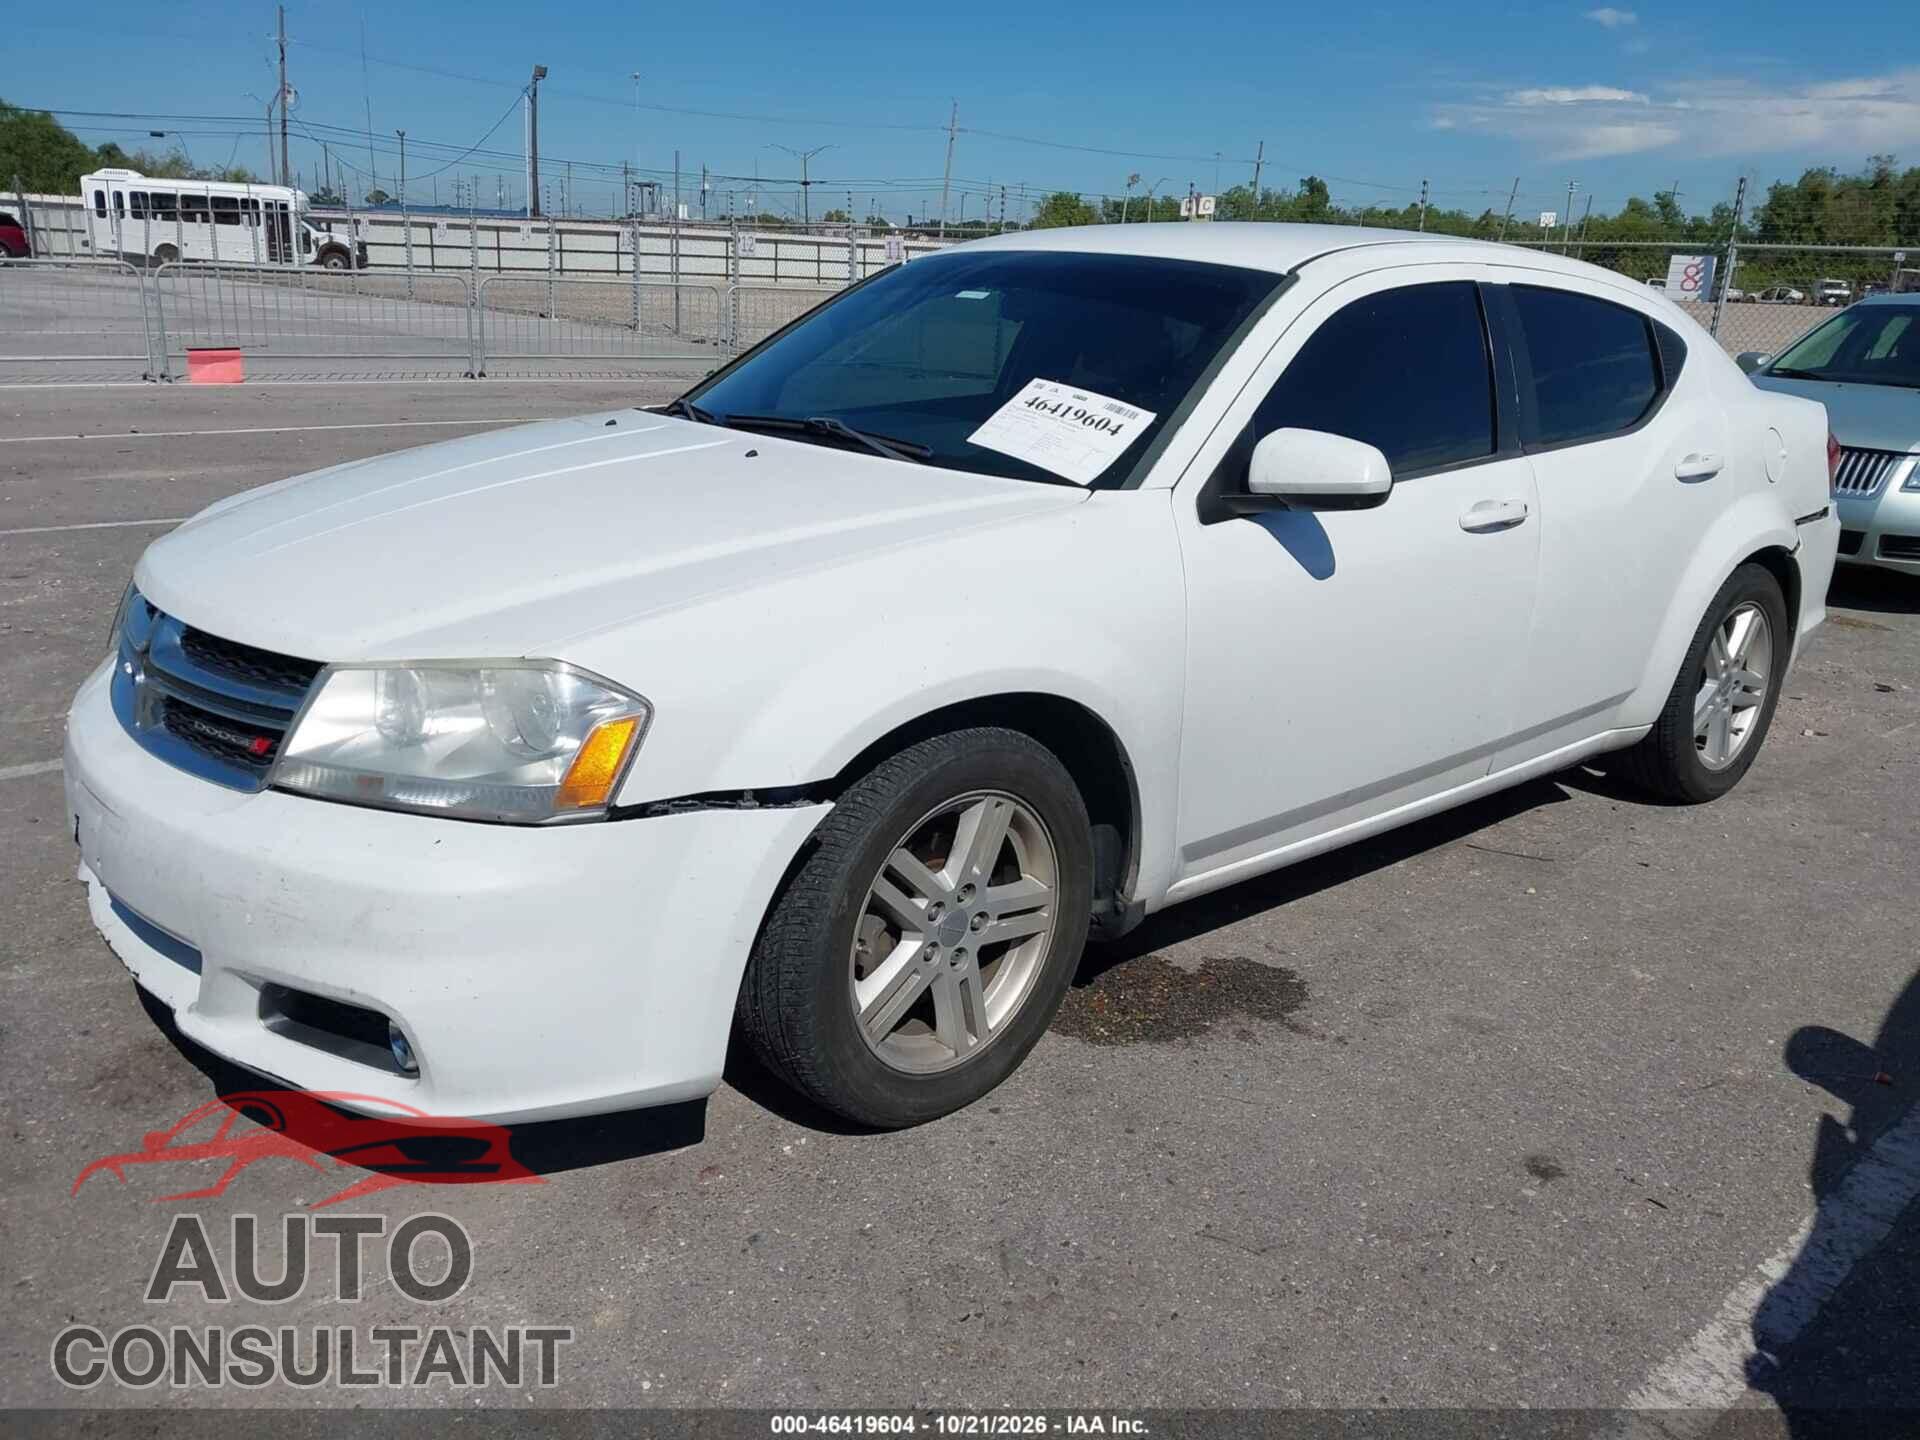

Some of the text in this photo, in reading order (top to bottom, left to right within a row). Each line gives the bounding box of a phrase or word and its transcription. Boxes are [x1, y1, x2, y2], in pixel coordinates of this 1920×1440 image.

[741, 235, 755, 252] 12
[886, 240, 902, 259] 11
[1680, 264, 1700, 292] 8
[1024, 396, 1124, 436] 46419604
[193, 720, 250, 747] DODGE
